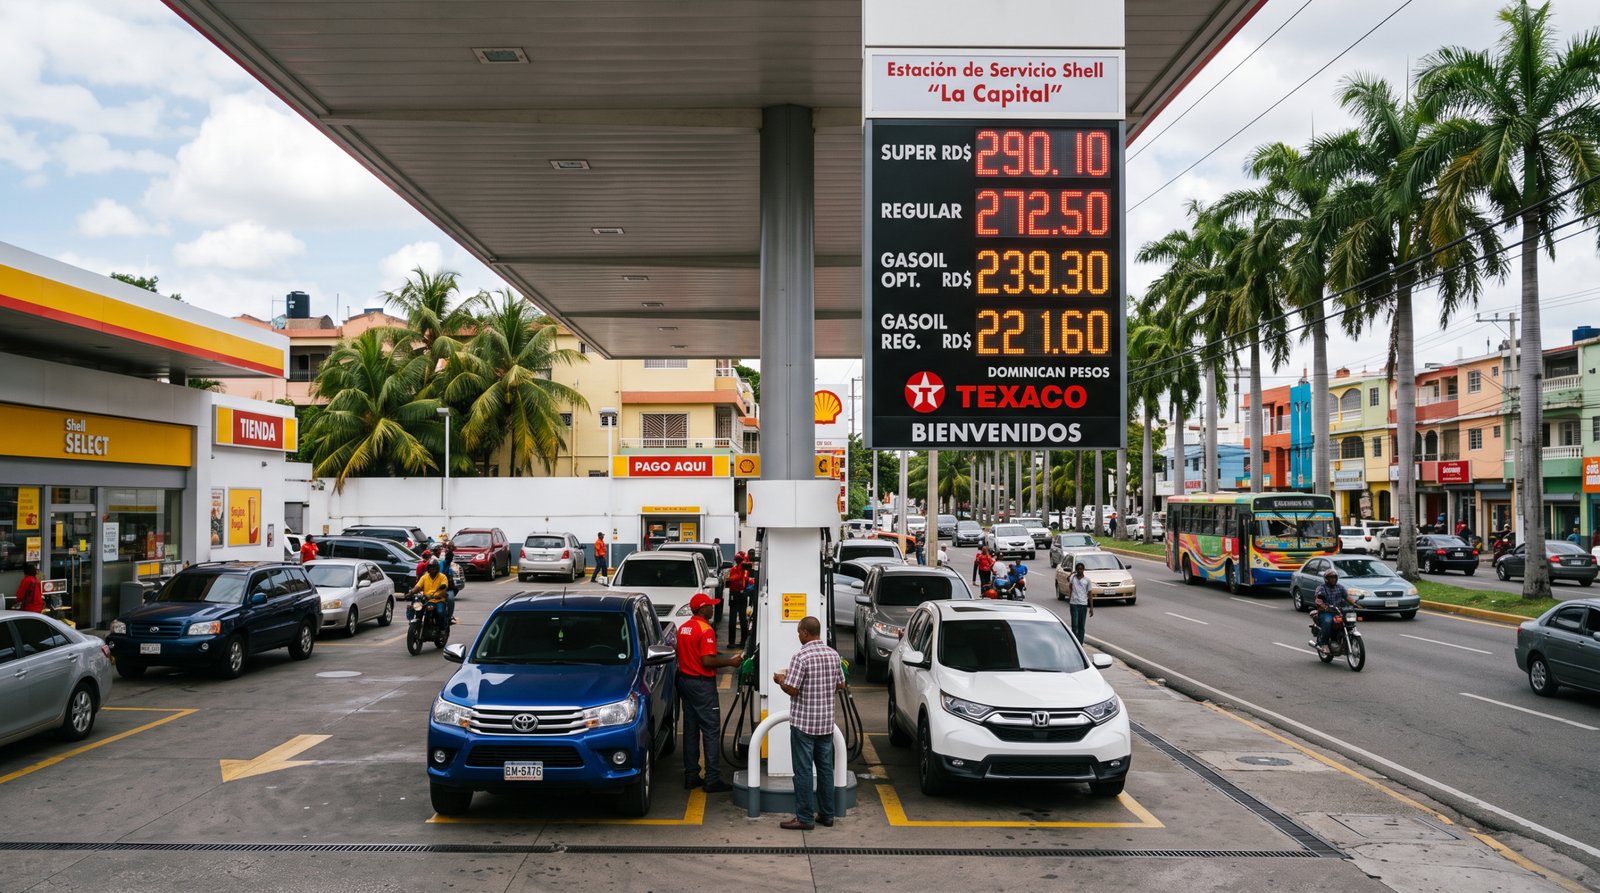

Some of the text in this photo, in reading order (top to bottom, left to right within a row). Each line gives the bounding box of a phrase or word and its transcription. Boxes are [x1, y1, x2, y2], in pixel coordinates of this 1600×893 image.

[887, 61, 1104, 78] Estación de Servicio Shell
[881, 145, 937, 160] SUPER
[941, 144, 972, 163] RD$
[881, 190, 1109, 236] REGULAR 272.50
[881, 252, 948, 268] GASOIL
[881, 250, 1109, 295] OPT. RD$ 239.30
[881, 313, 948, 329] GASOIL
[881, 333, 921, 349] REG.
[942, 332, 972, 350] RD$
[988, 366, 1110, 378] DOMINICAN PESOS
[956, 385, 1087, 408] TEXACO
[66, 418, 86, 432] Shell
[240, 418, 276, 442] TIENDA
[912, 422, 1082, 442] BIENVENIDOS
[66, 432, 109, 455] SELECT
[635, 461, 706, 472] PAGO AQUI
